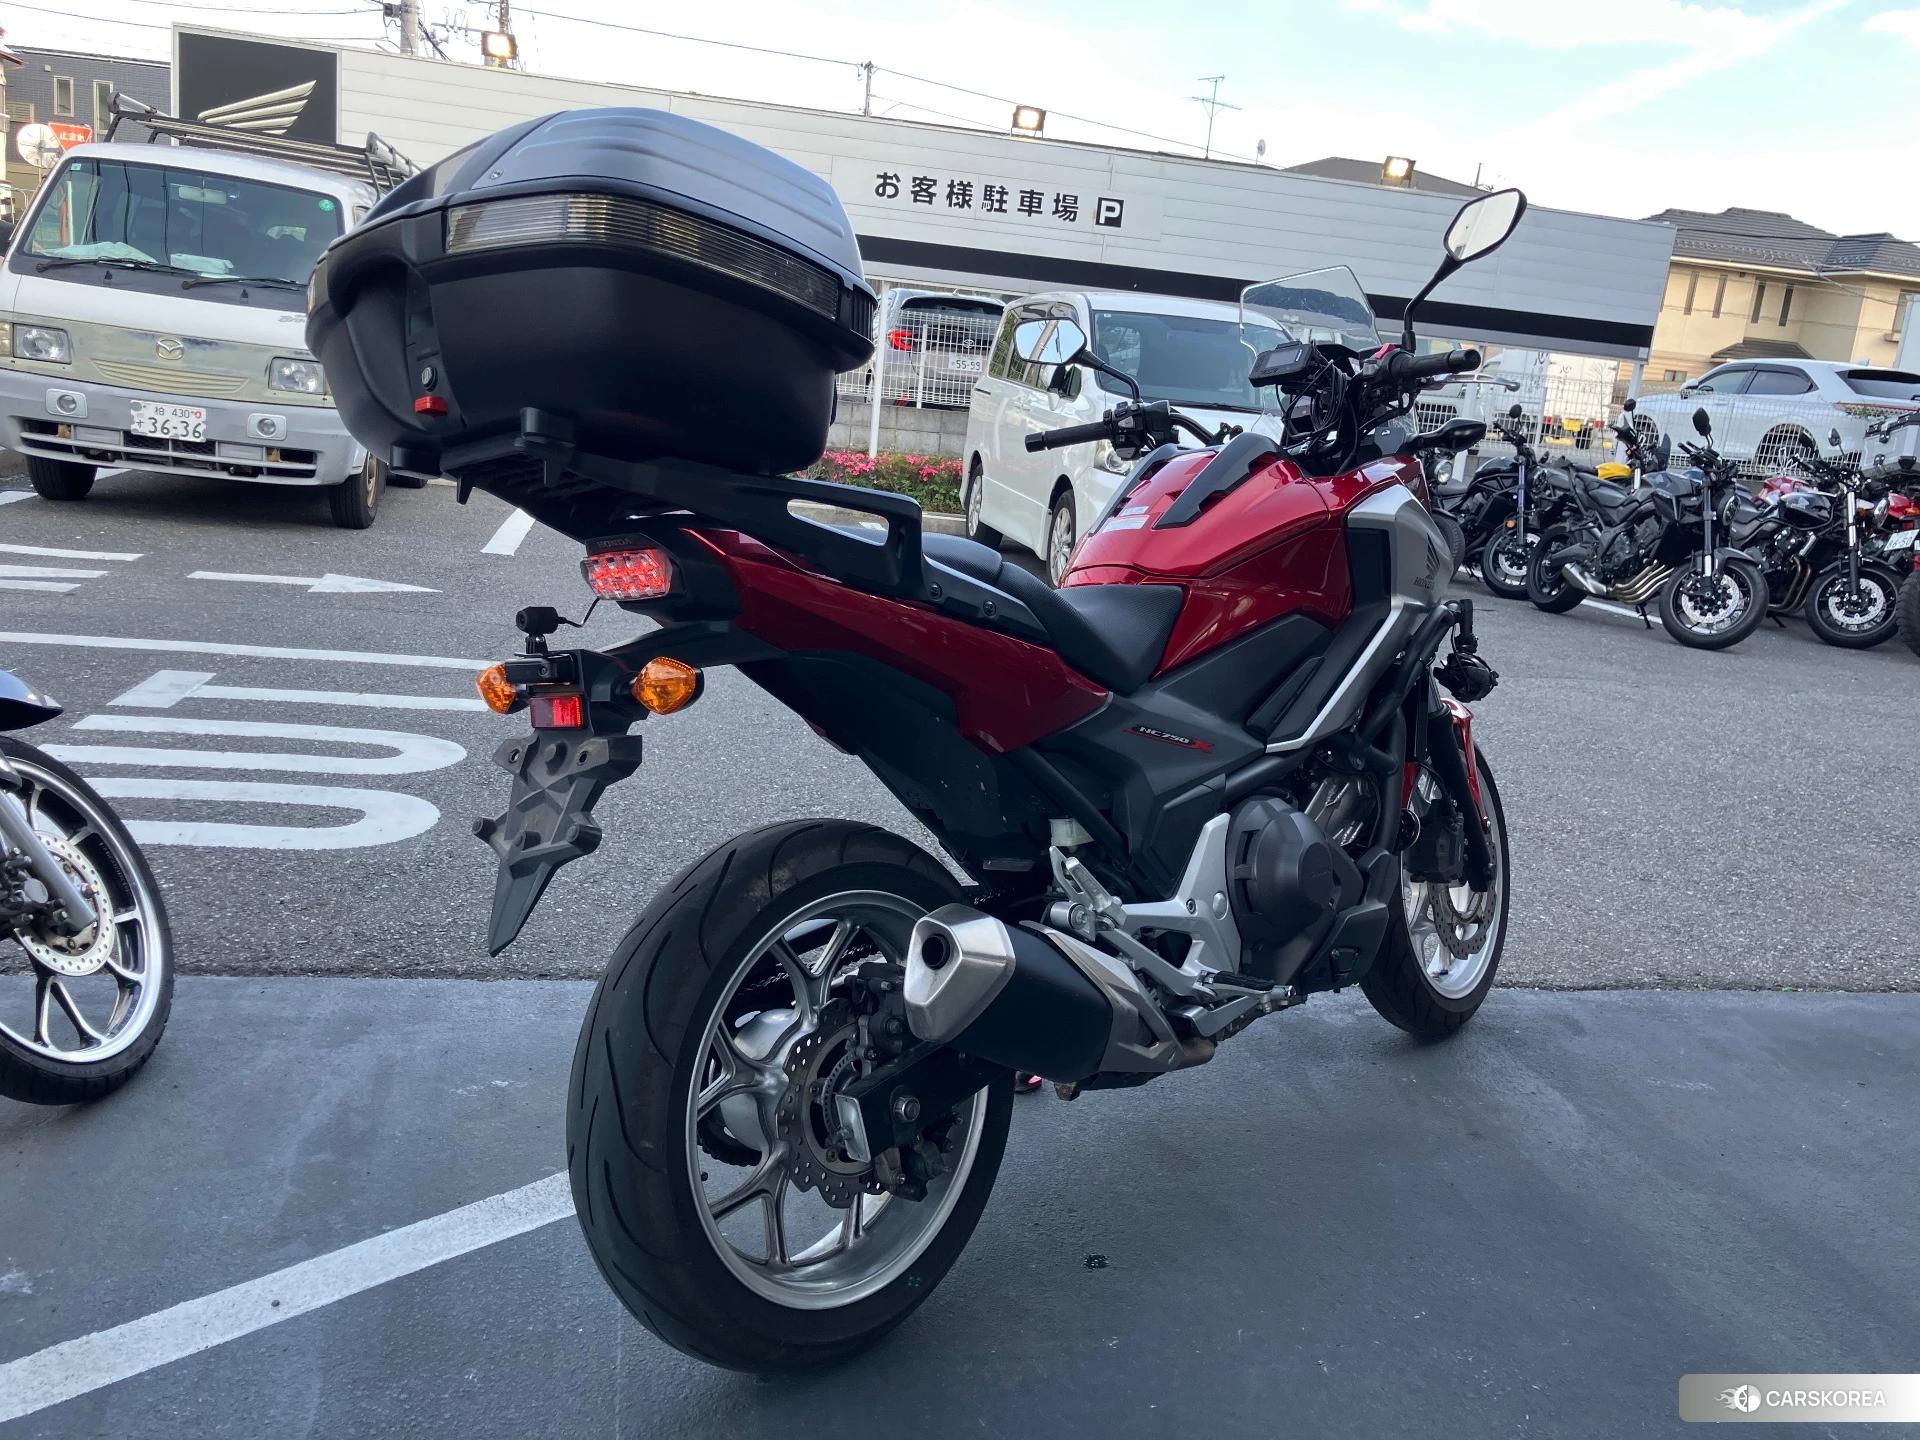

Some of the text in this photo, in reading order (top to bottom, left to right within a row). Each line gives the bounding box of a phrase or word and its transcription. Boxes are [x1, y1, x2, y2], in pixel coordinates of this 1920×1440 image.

[59, 131, 85, 142] 止まれ
[874, 172, 1121, 225] お客様駐車場 P
[171, 408, 190, 418] 430
[147, 417, 202, 438] 36-36
[597, 539, 632, 548] HONDA
